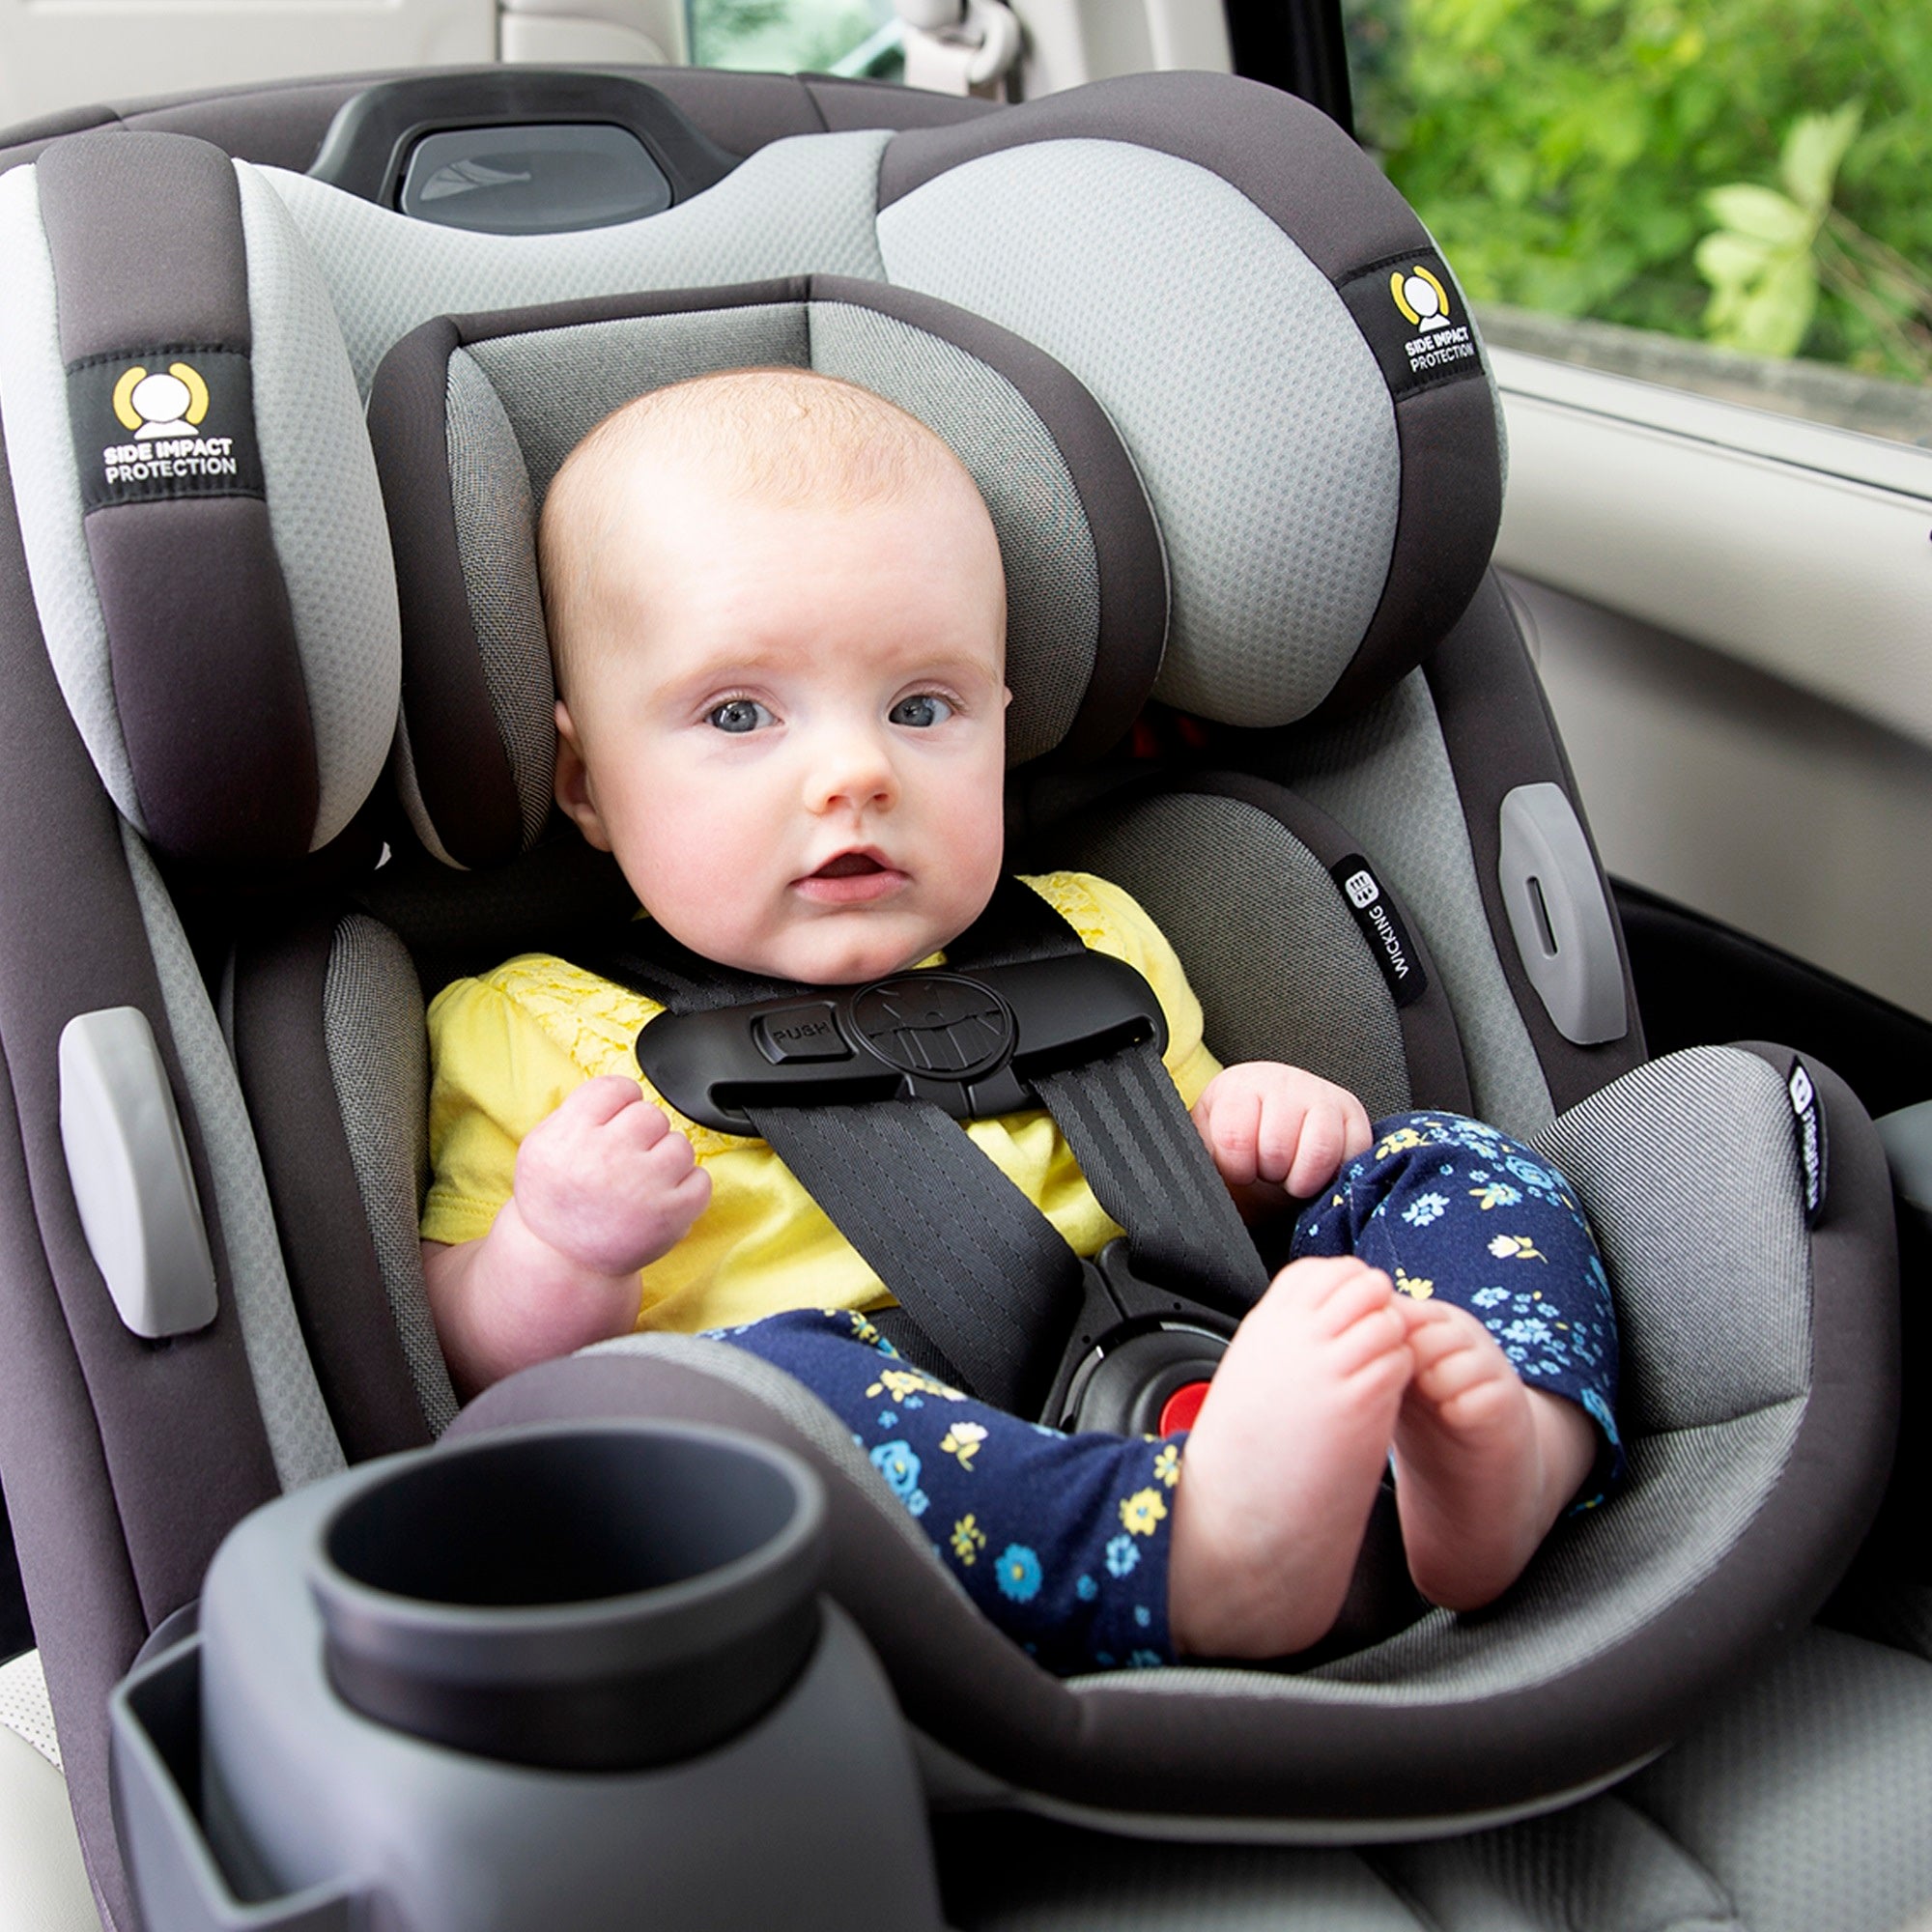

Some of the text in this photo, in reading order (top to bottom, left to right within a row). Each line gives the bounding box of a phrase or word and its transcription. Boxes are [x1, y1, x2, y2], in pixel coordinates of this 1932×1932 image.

[1405, 327, 1469, 356] SIDE IMPACT
[1409, 342, 1475, 373] PROTECTION
[103, 438, 233, 465] SIDE IMPACT
[104, 457, 238, 484] PROTECTION
[1369, 905, 1409, 980] WICKING
[773, 1021, 832, 1043] PUSH
